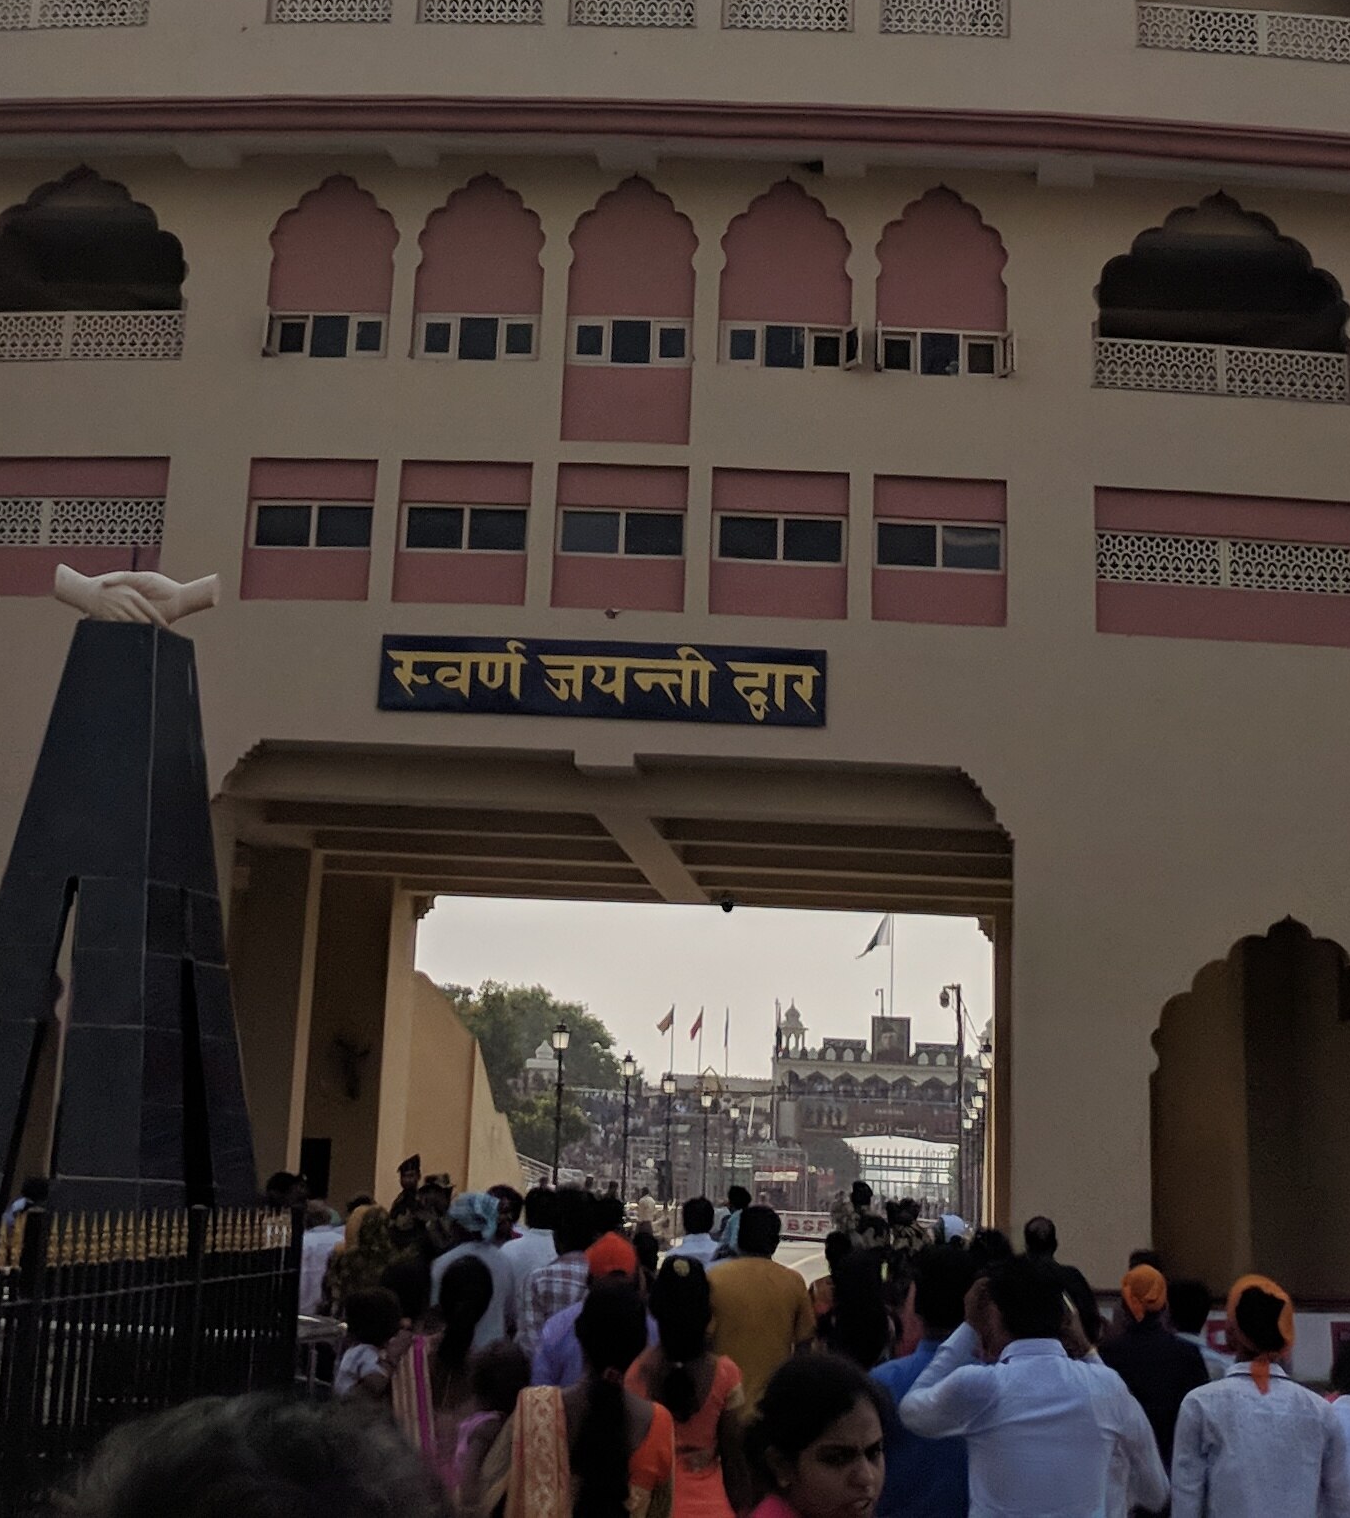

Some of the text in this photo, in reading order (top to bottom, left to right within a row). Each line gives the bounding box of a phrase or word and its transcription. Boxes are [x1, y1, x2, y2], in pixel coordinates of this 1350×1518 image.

[387, 640, 821, 721] स्वर्ण जयन्ती द्वार
[787, 1219, 830, 1232] BSF
